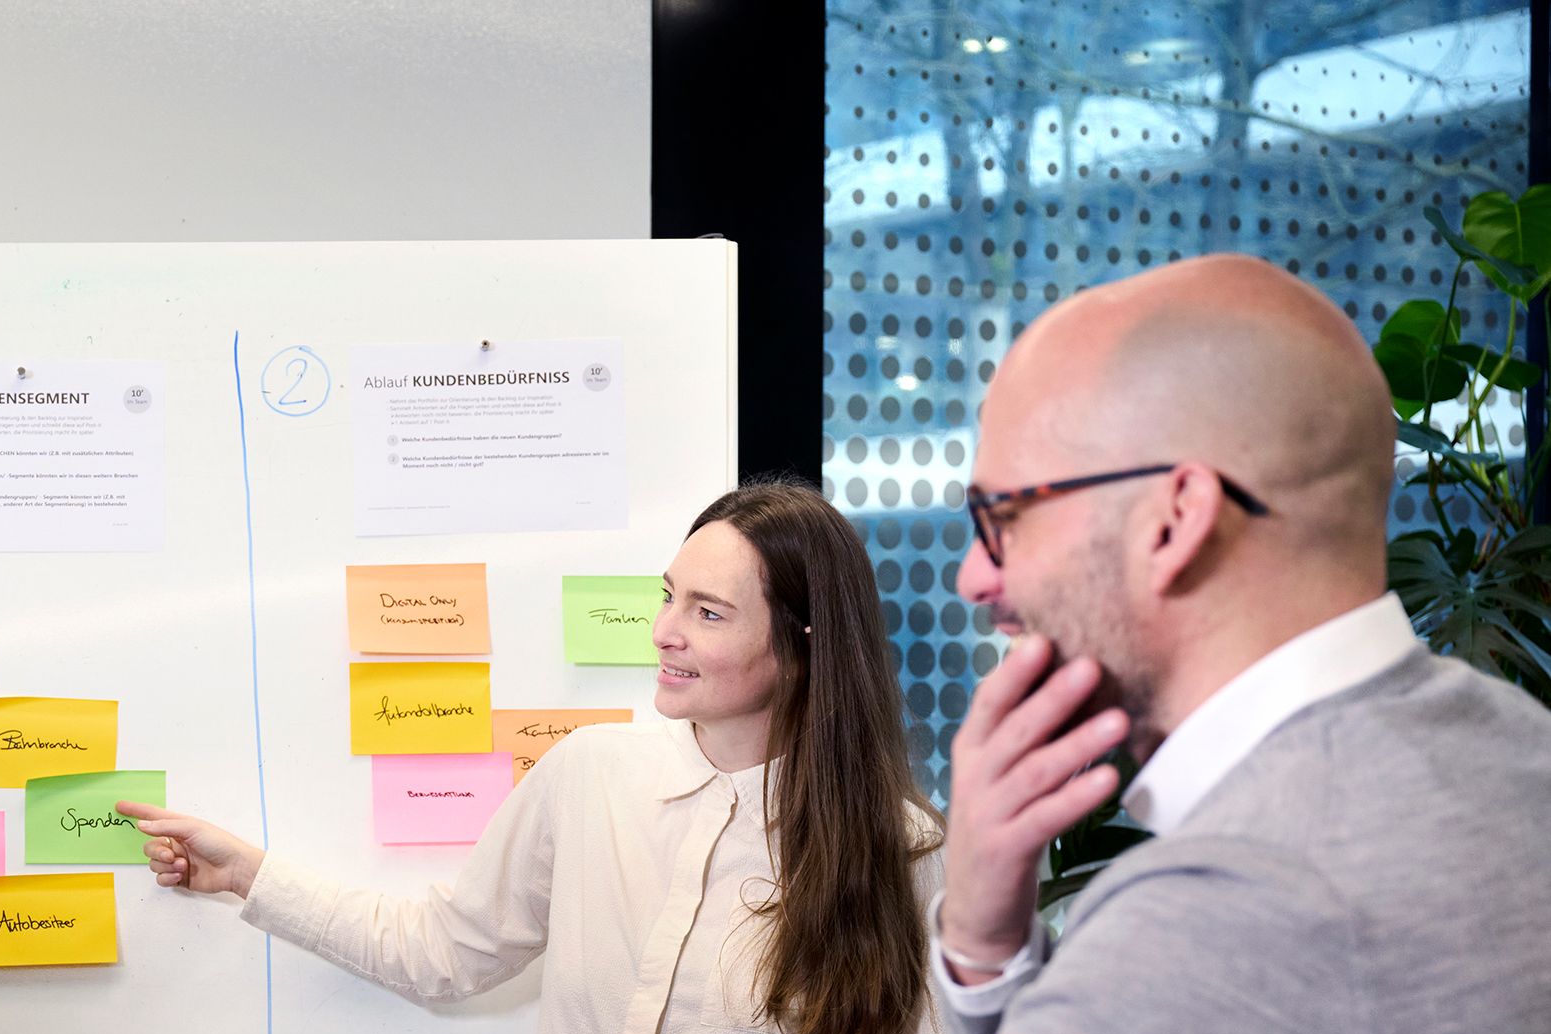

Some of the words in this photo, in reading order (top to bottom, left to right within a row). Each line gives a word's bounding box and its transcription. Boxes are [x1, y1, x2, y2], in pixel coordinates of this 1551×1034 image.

[279, 358, 309, 406] 2
[364, 375, 409, 389] Ablauf
[412, 370, 570, 387] KUNDENBEDÜRFNISS
[60, 808, 135, 838] Spenden
